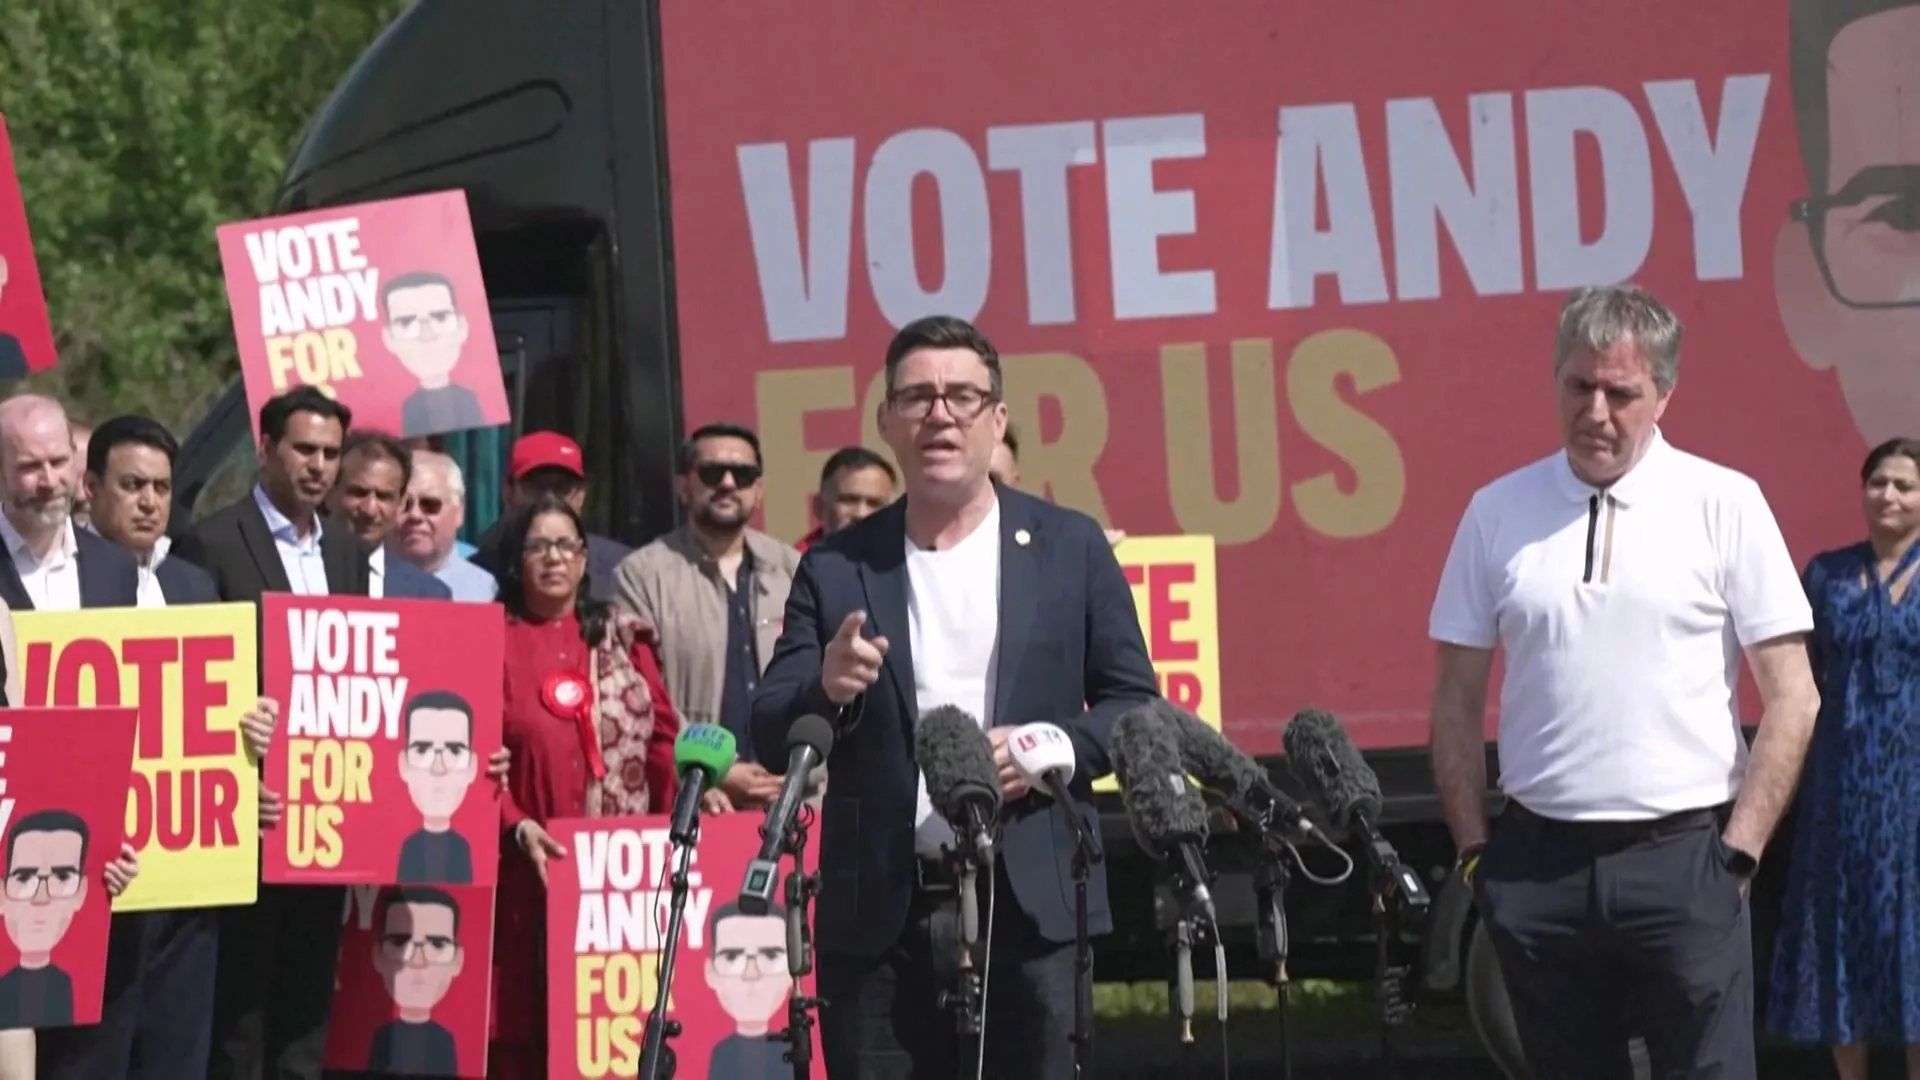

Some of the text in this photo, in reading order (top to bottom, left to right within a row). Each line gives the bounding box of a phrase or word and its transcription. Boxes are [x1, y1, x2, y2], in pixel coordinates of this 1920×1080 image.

[737, 73, 1771, 343] VOTE ANDY
[244, 217, 367, 283] VOTE
[259, 267, 379, 337] ANDY
[265, 327, 363, 392] FOR
[755, 328, 1405, 546] FR US
[287, 608, 400, 674] VOTE
[287, 673, 409, 739] ANDY
[287, 738, 373, 803] FOR
[286, 803, 344, 868] US
[574, 888, 713, 953] ANDY
[576, 1015, 642, 1078] US
